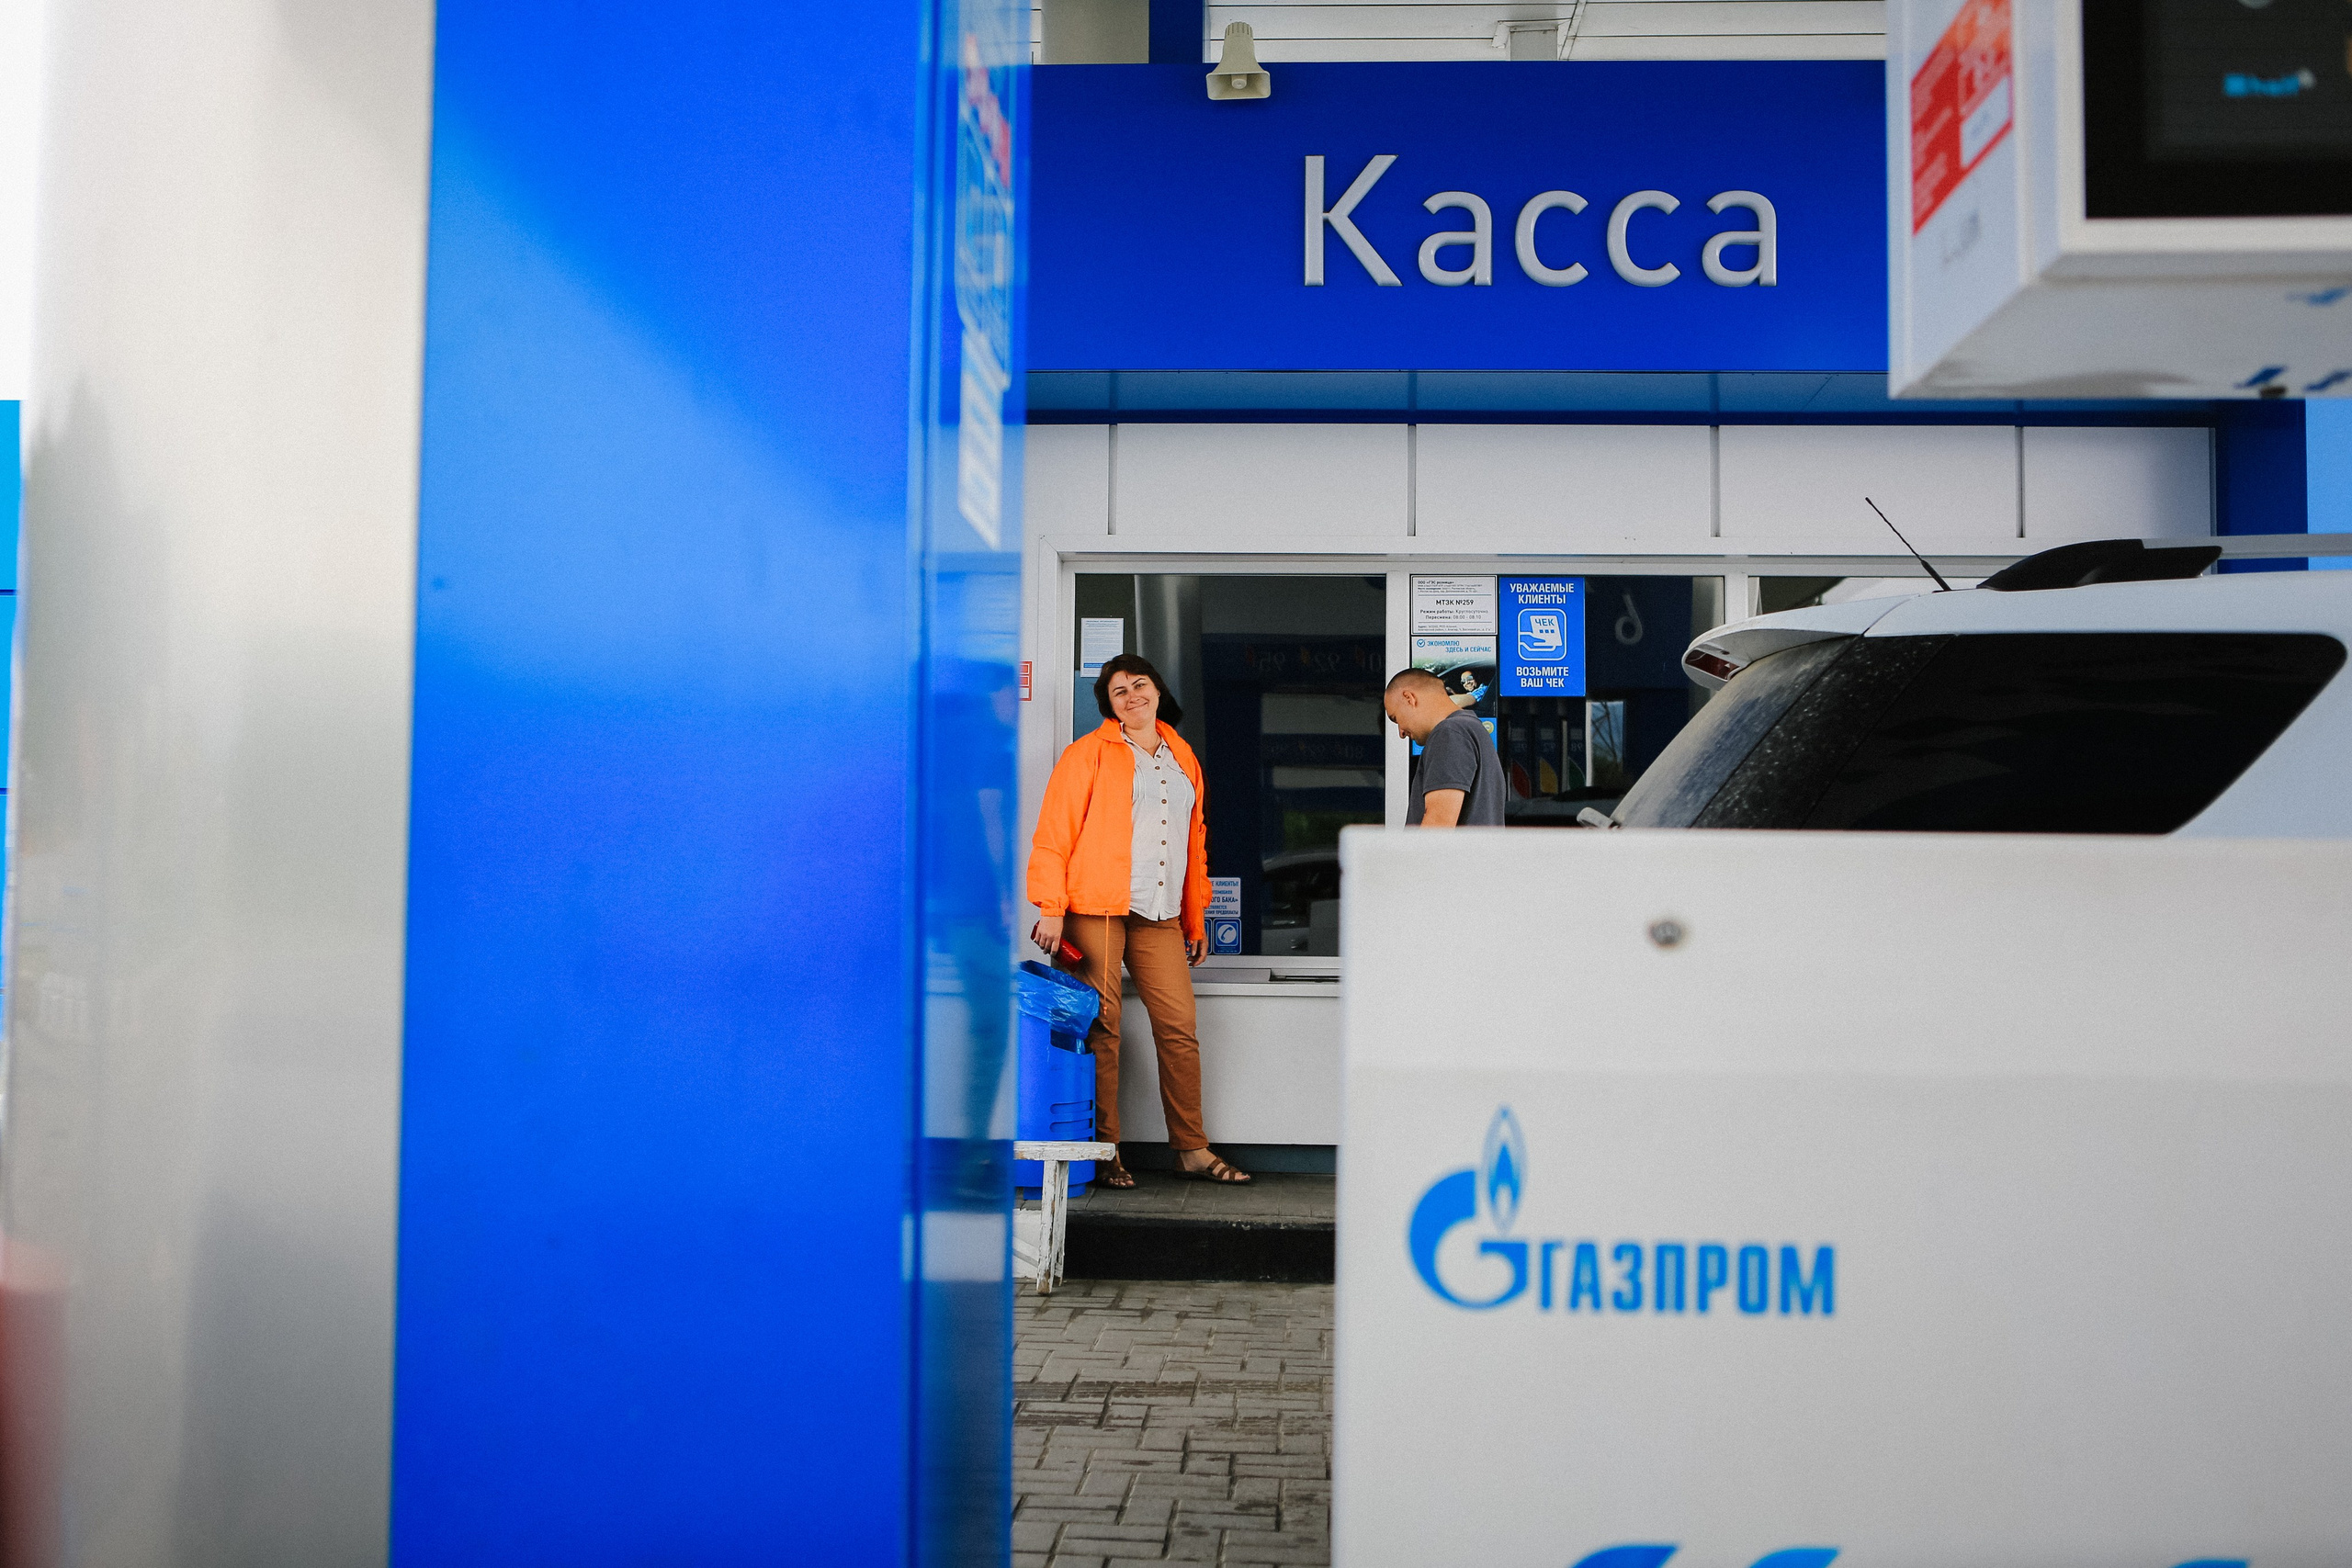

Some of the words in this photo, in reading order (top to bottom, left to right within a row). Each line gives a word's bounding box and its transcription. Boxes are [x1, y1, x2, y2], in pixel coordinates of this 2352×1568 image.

[1304, 153, 1778, 288] Касса
[1510, 583, 1575, 593] УВАЖАЕМЫЕ
[1518, 594, 1566, 604] КЛИЕНТЫ
[1534, 618, 1555, 626] ЧЕК
[1516, 667, 1569, 677] ВОЗЬМИТЕ
[1521, 678, 1544, 688] ВАШ
[1546, 678, 1565, 688] ЧЕК
[1540, 1242, 1835, 1315] ГАЗПРОМ
